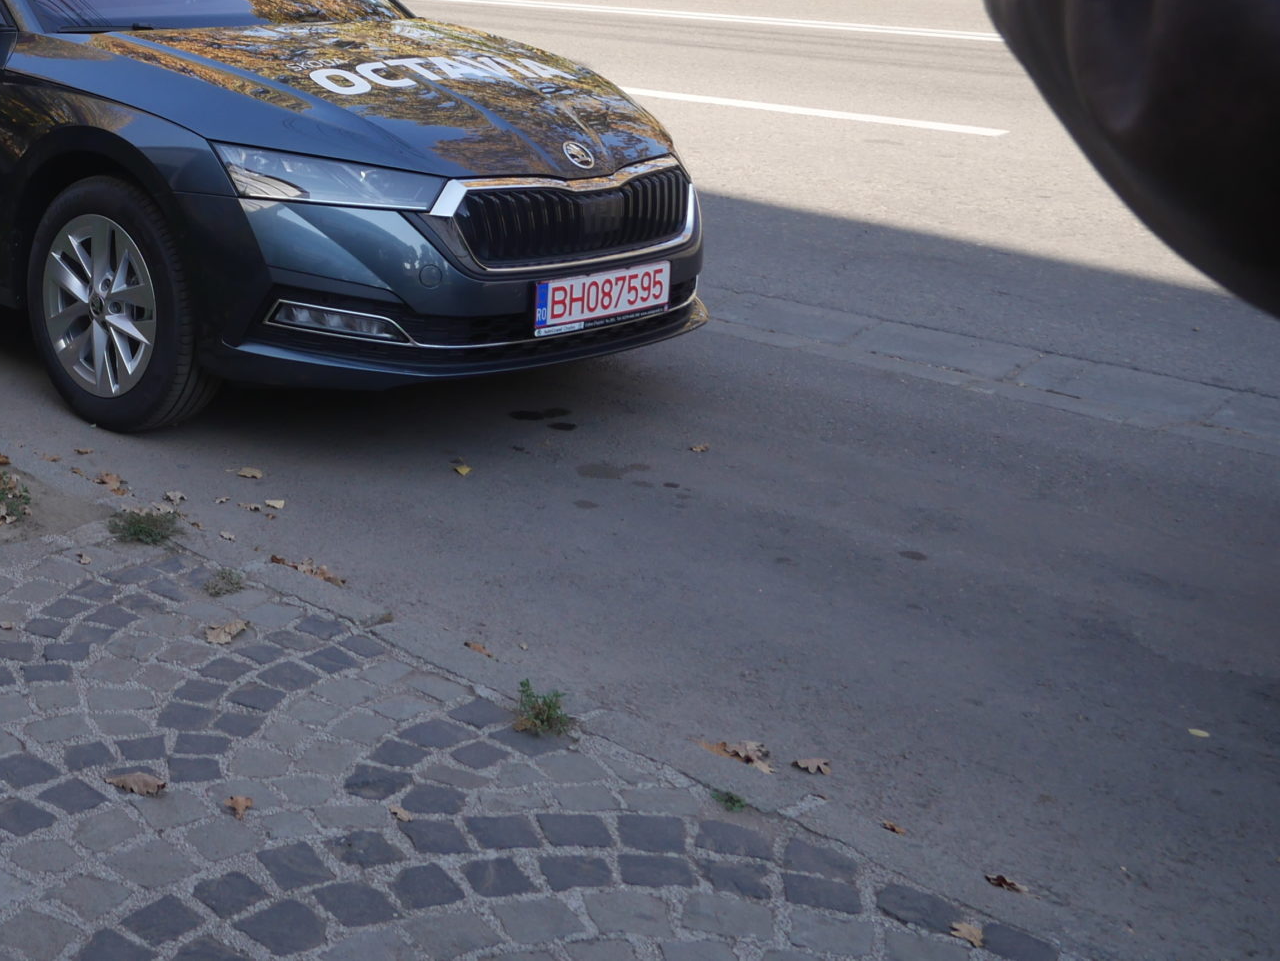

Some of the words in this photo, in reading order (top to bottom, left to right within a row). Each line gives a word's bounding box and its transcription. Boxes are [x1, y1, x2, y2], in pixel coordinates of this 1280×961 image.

[309, 56, 577, 95] OCTAVIA
[550, 268, 664, 319] BH087595
[536, 307, 547, 322] RO
